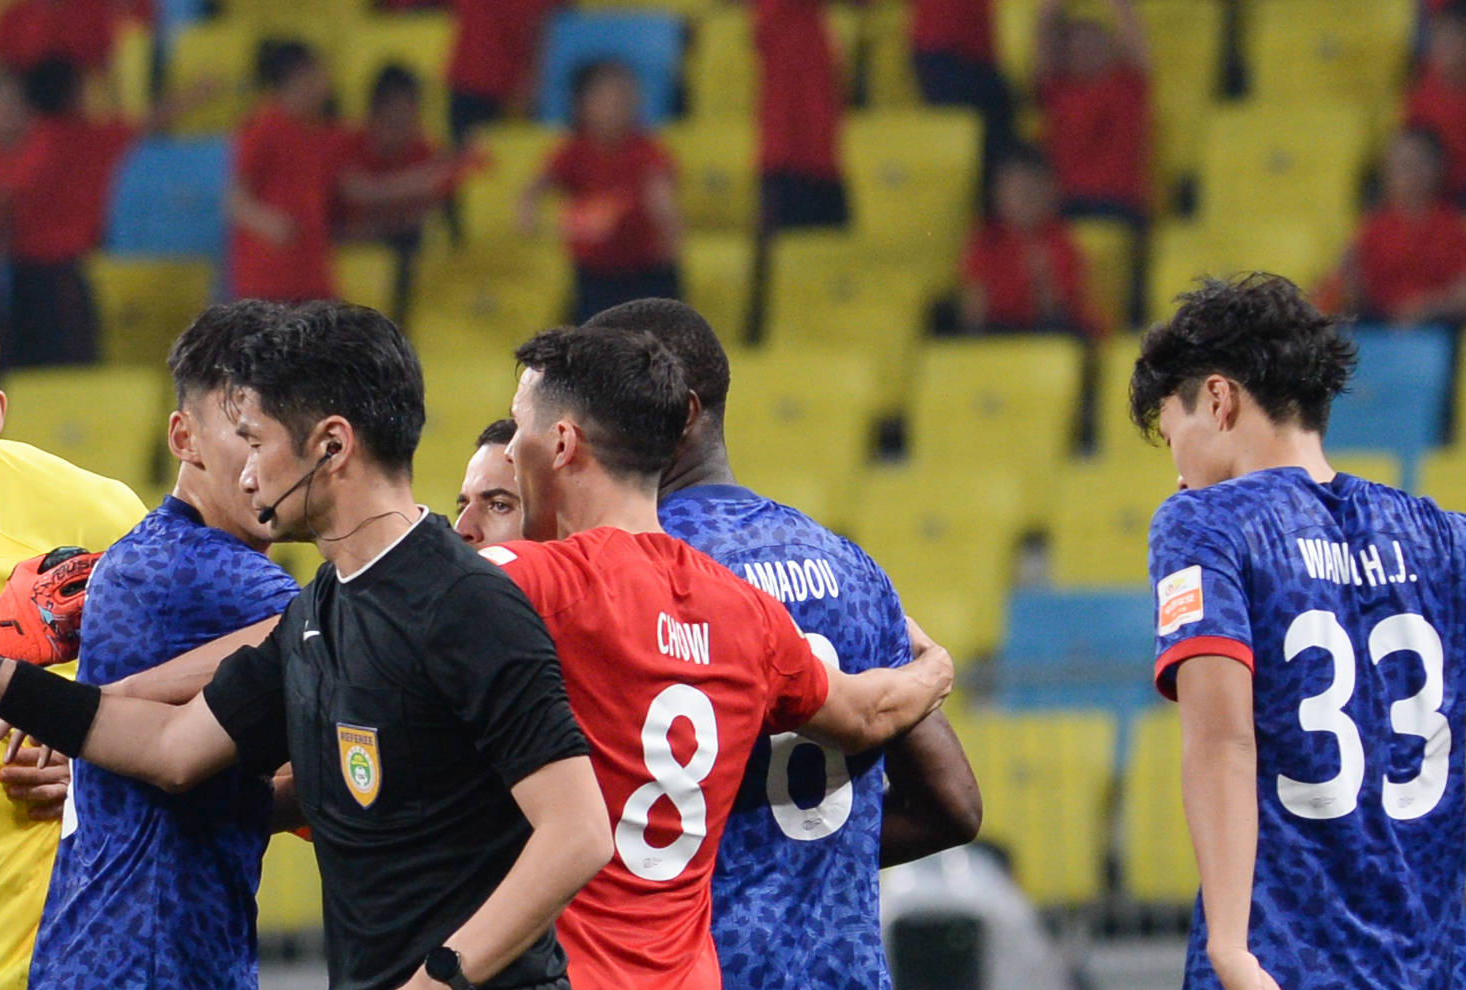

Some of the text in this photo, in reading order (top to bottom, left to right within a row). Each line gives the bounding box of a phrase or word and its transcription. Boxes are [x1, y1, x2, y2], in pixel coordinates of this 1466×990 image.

[657, 611, 710, 665] CHOW
[743, 558, 839, 603] AMADOU
[1276, 609, 1452, 820] 33
[615, 683, 719, 881] 8
